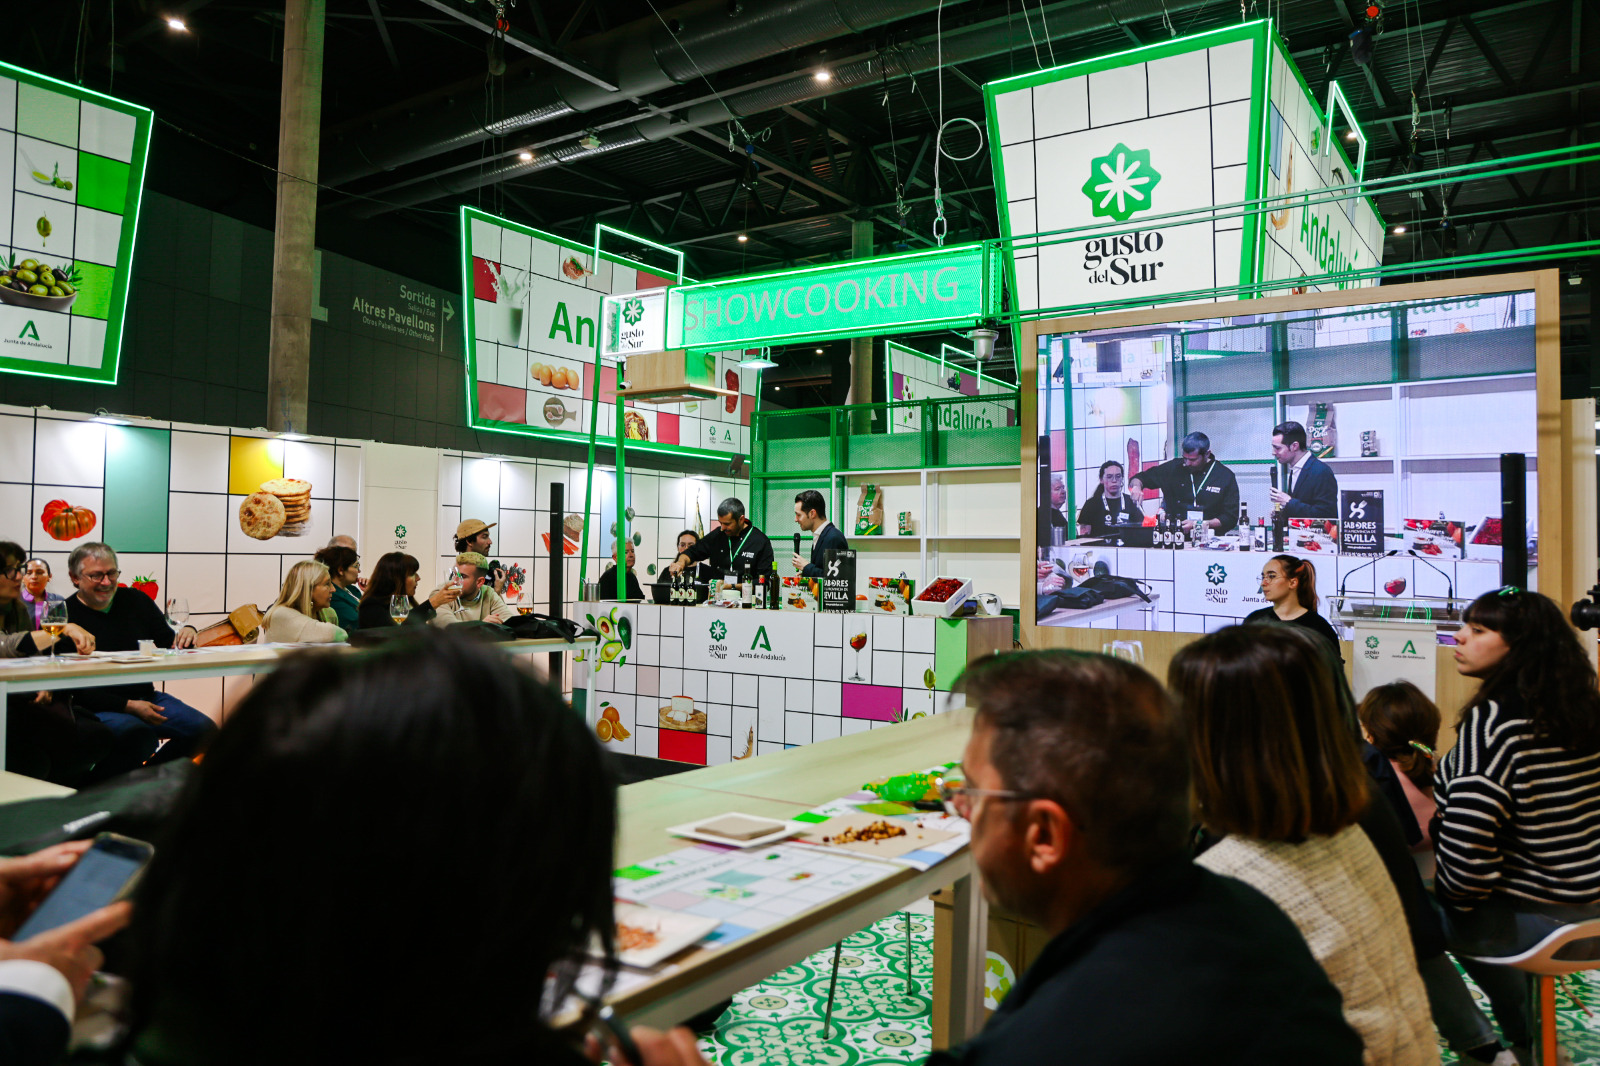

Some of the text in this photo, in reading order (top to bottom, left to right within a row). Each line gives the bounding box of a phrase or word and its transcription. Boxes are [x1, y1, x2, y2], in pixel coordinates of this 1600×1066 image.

[1083, 232, 1164, 270] gusto
[1088, 257, 1164, 285] del Sur
[400, 285, 436, 308] Sortida
[684, 267, 959, 331] SHOWCOOKING
[353, 297, 435, 333] Altres Pavellons
[426, 308, 436, 318] Exit
[621, 329, 644, 340] gusto
[628, 340, 643, 349] Sur
[1343, 521, 1377, 529] SABORES
[1344, 534, 1377, 543] SEVILLA
[1205, 587, 1228, 598] gusto
[1212, 595, 1228, 603] Sur
[709, 643, 728, 654] gusto
[714, 651, 727, 660] Sur
[739, 651, 753, 659] Junta
[760, 653, 786, 661] Andalucía
